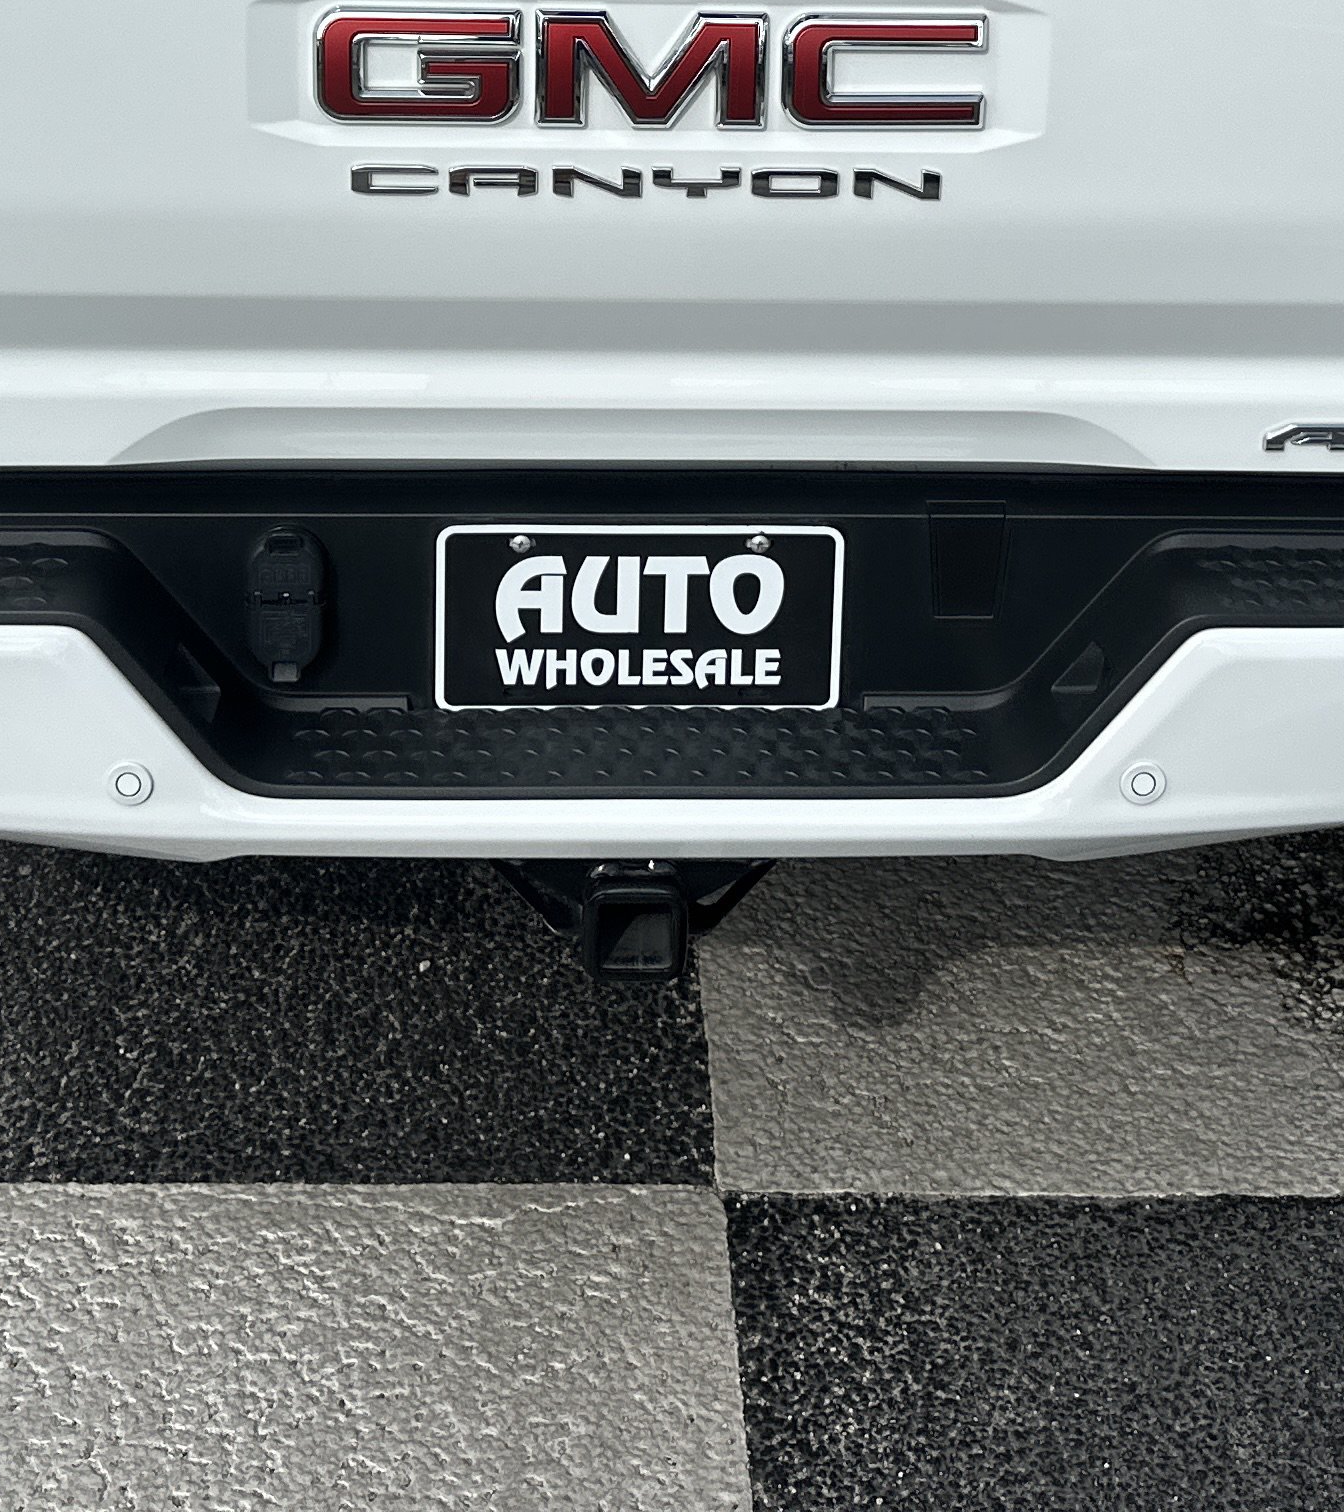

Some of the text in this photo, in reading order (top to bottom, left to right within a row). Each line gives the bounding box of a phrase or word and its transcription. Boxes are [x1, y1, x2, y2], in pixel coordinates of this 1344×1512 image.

[315, 6, 989, 130] GMC
[351, 164, 942, 200] CANYON
[495, 554, 785, 643] AUTO
[495, 648, 782, 690] WHOLESALE
